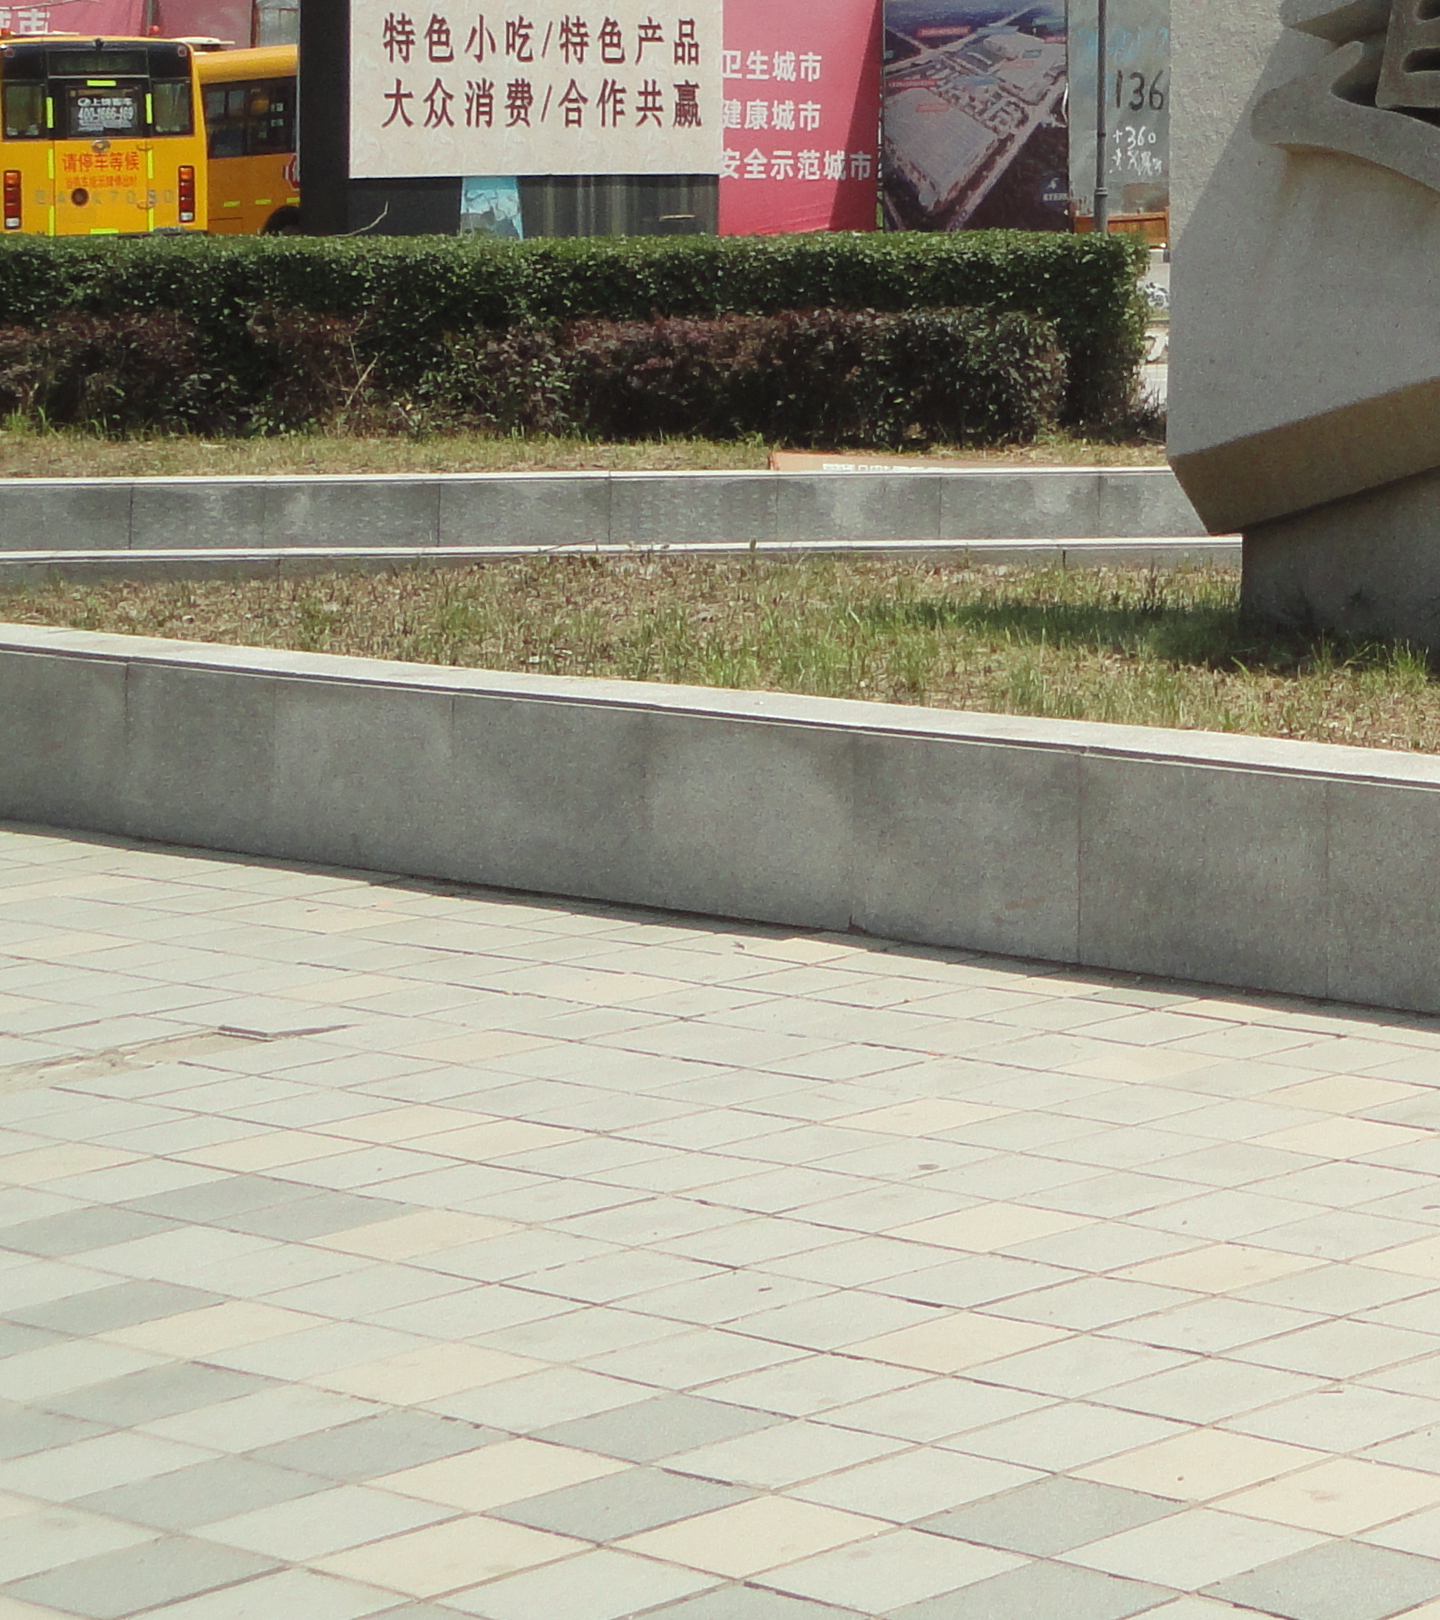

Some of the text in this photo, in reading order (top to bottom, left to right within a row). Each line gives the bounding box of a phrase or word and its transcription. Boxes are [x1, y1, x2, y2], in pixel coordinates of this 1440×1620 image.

[382, 12, 703, 66] 特色小吃/特色产品
[722, 49, 822, 83] 卫生城市
[381, 77, 703, 130] 大众消费/合作共赢
[722, 98, 821, 132] 健康城市
[61, 151, 139, 173] 请停车等候
[719, 147, 873, 181] 安全示范城市
